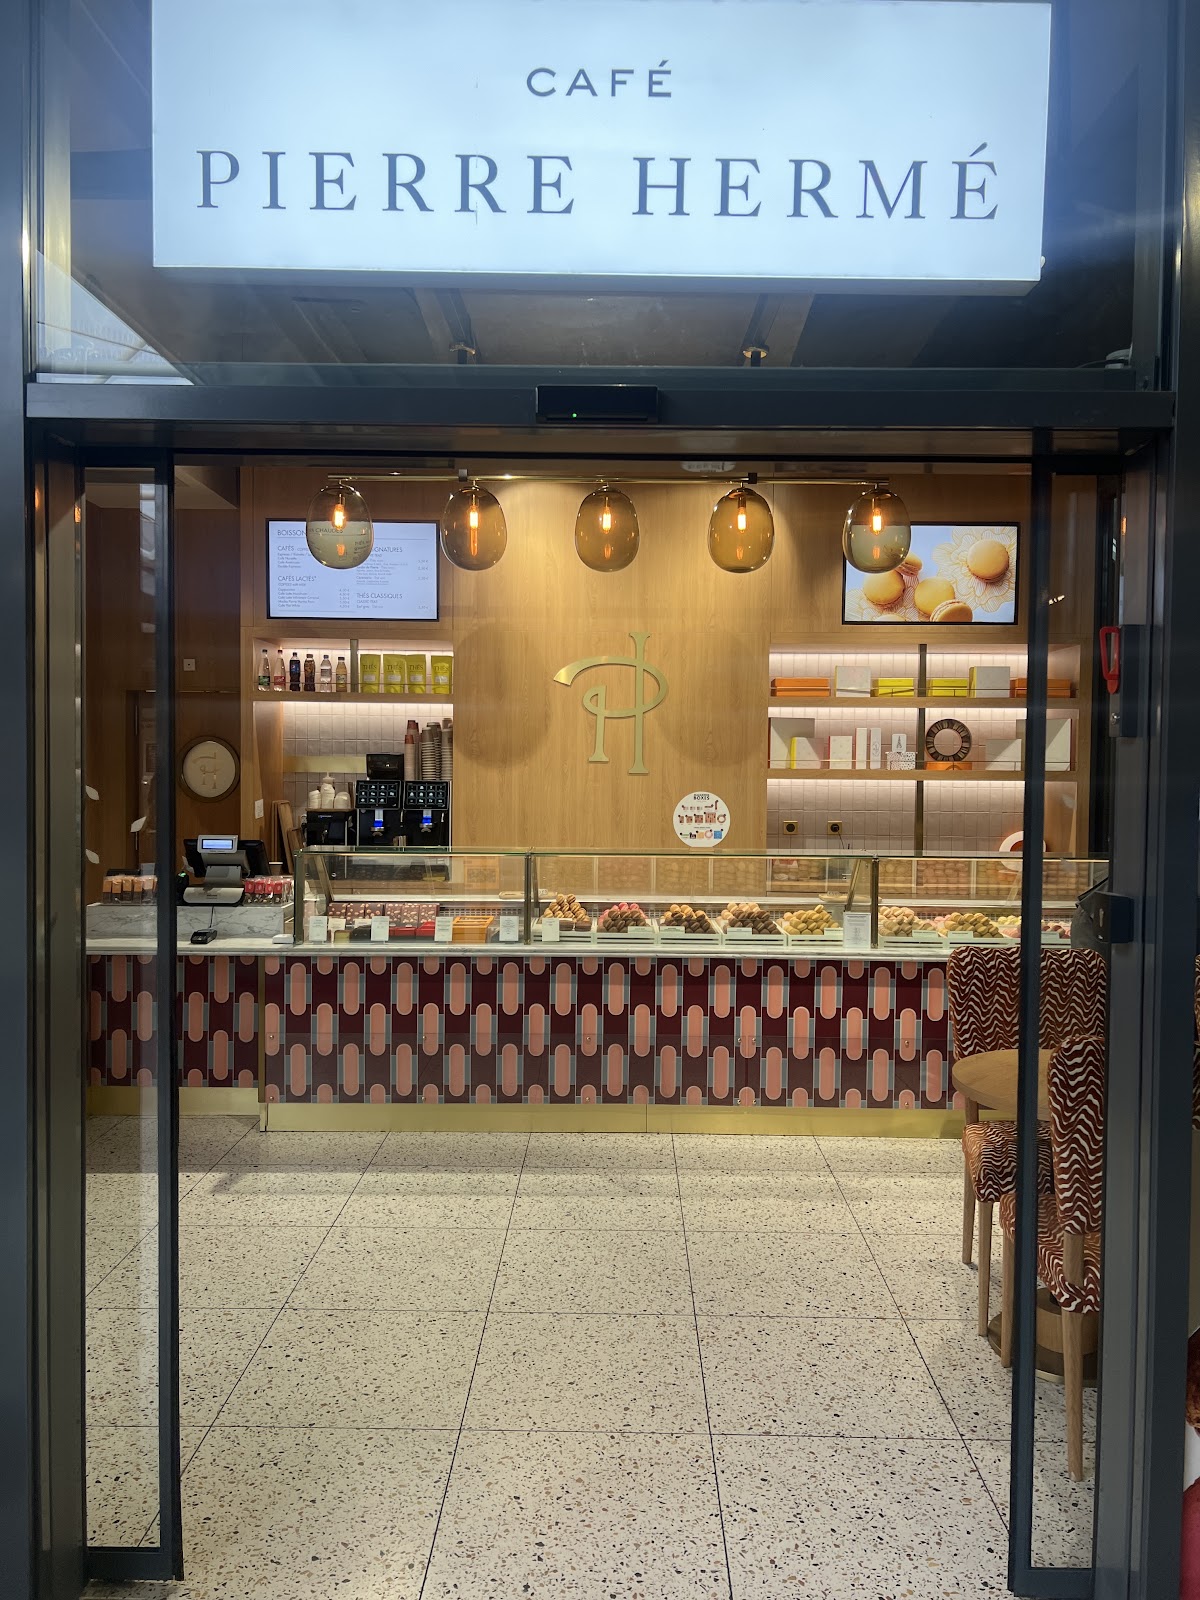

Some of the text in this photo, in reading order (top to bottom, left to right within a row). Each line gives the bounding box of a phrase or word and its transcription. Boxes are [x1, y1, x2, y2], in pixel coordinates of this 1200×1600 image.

[526, 60, 673, 98] CAFÉ
[195, 141, 1000, 221] PIERRE HERMÉ
